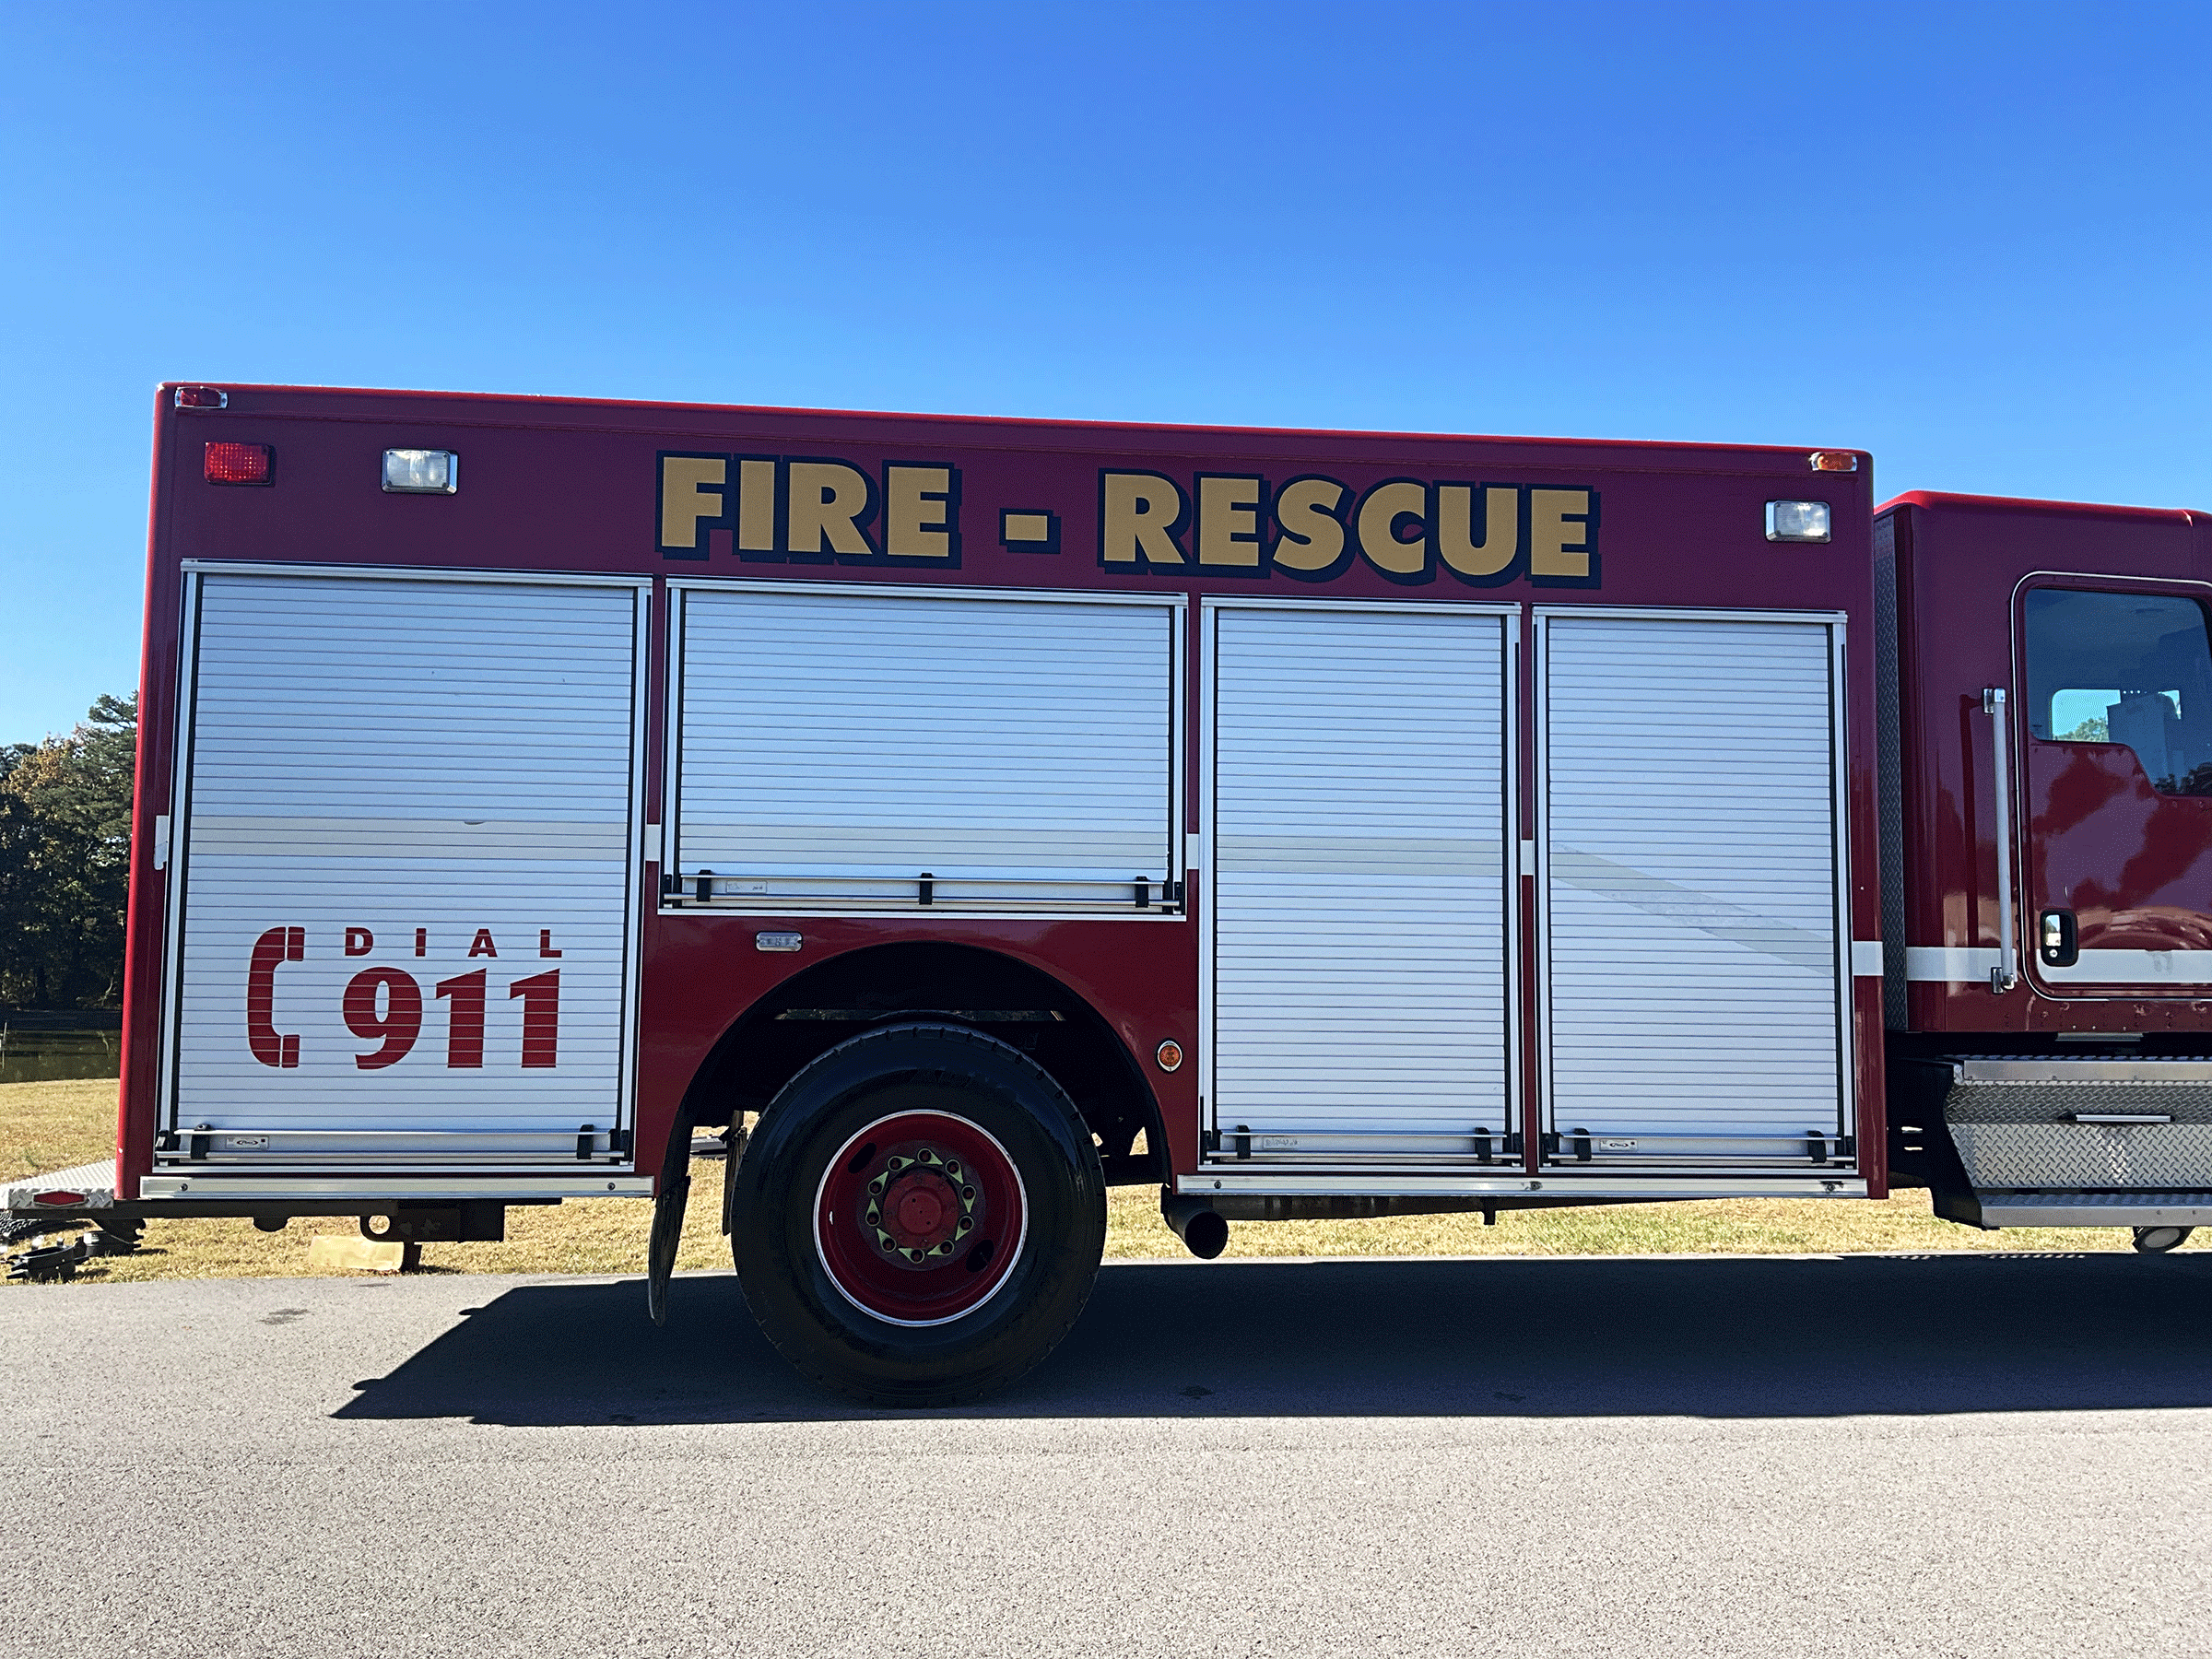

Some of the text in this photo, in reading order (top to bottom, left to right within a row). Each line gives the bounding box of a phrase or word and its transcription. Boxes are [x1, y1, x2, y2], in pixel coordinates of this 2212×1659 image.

[660, 454, 1594, 580] FIRE - RESCUE
[345, 926, 563, 959] DIAL
[342, 966, 561, 1070] 911
